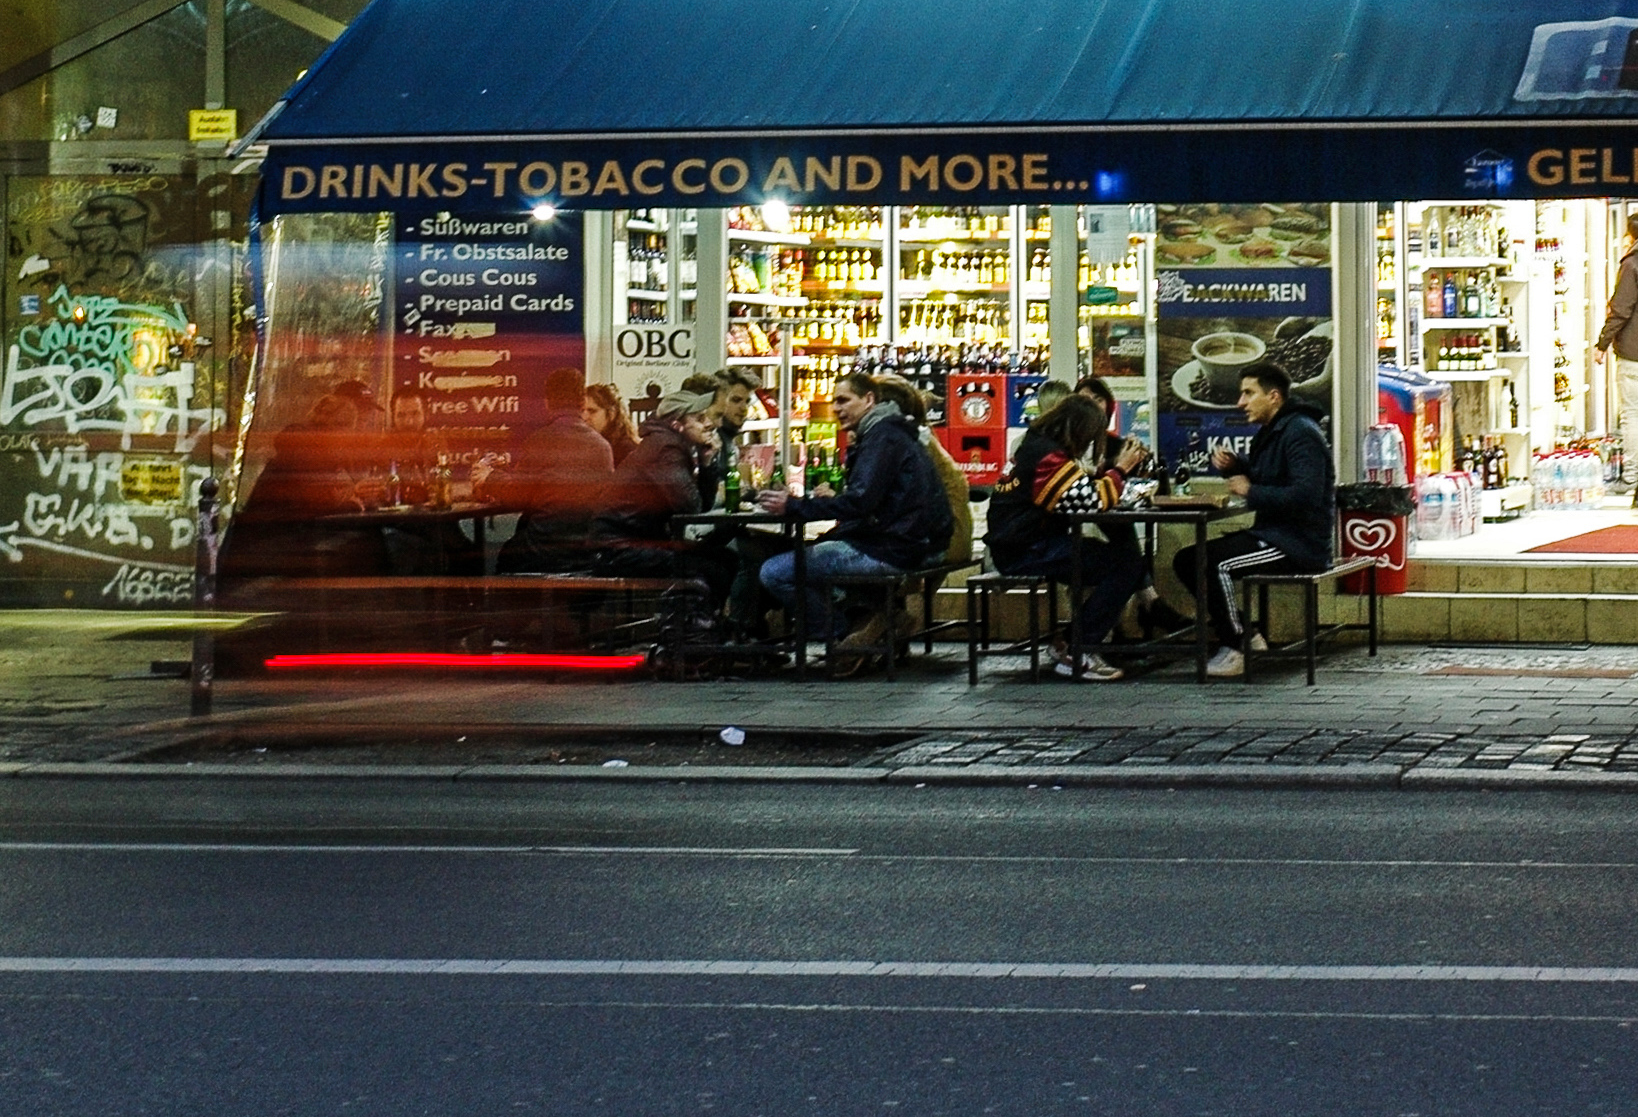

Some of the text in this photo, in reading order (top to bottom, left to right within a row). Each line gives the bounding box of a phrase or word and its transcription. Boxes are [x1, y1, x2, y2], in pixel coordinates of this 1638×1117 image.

[281, 153, 1090, 200] DRINKS-TOBACCO AND MORE...
[420, 218, 528, 235] Süßwaren
[420, 243, 569, 261] Fr. Obstsalate
[420, 269, 537, 286] Cous Cous
[420, 294, 575, 315] Prepaid Cards
[617, 329, 691, 359] OBC
[427, 396, 519, 414] ree Wifi
[1206, 436, 1253, 455] KAFF
